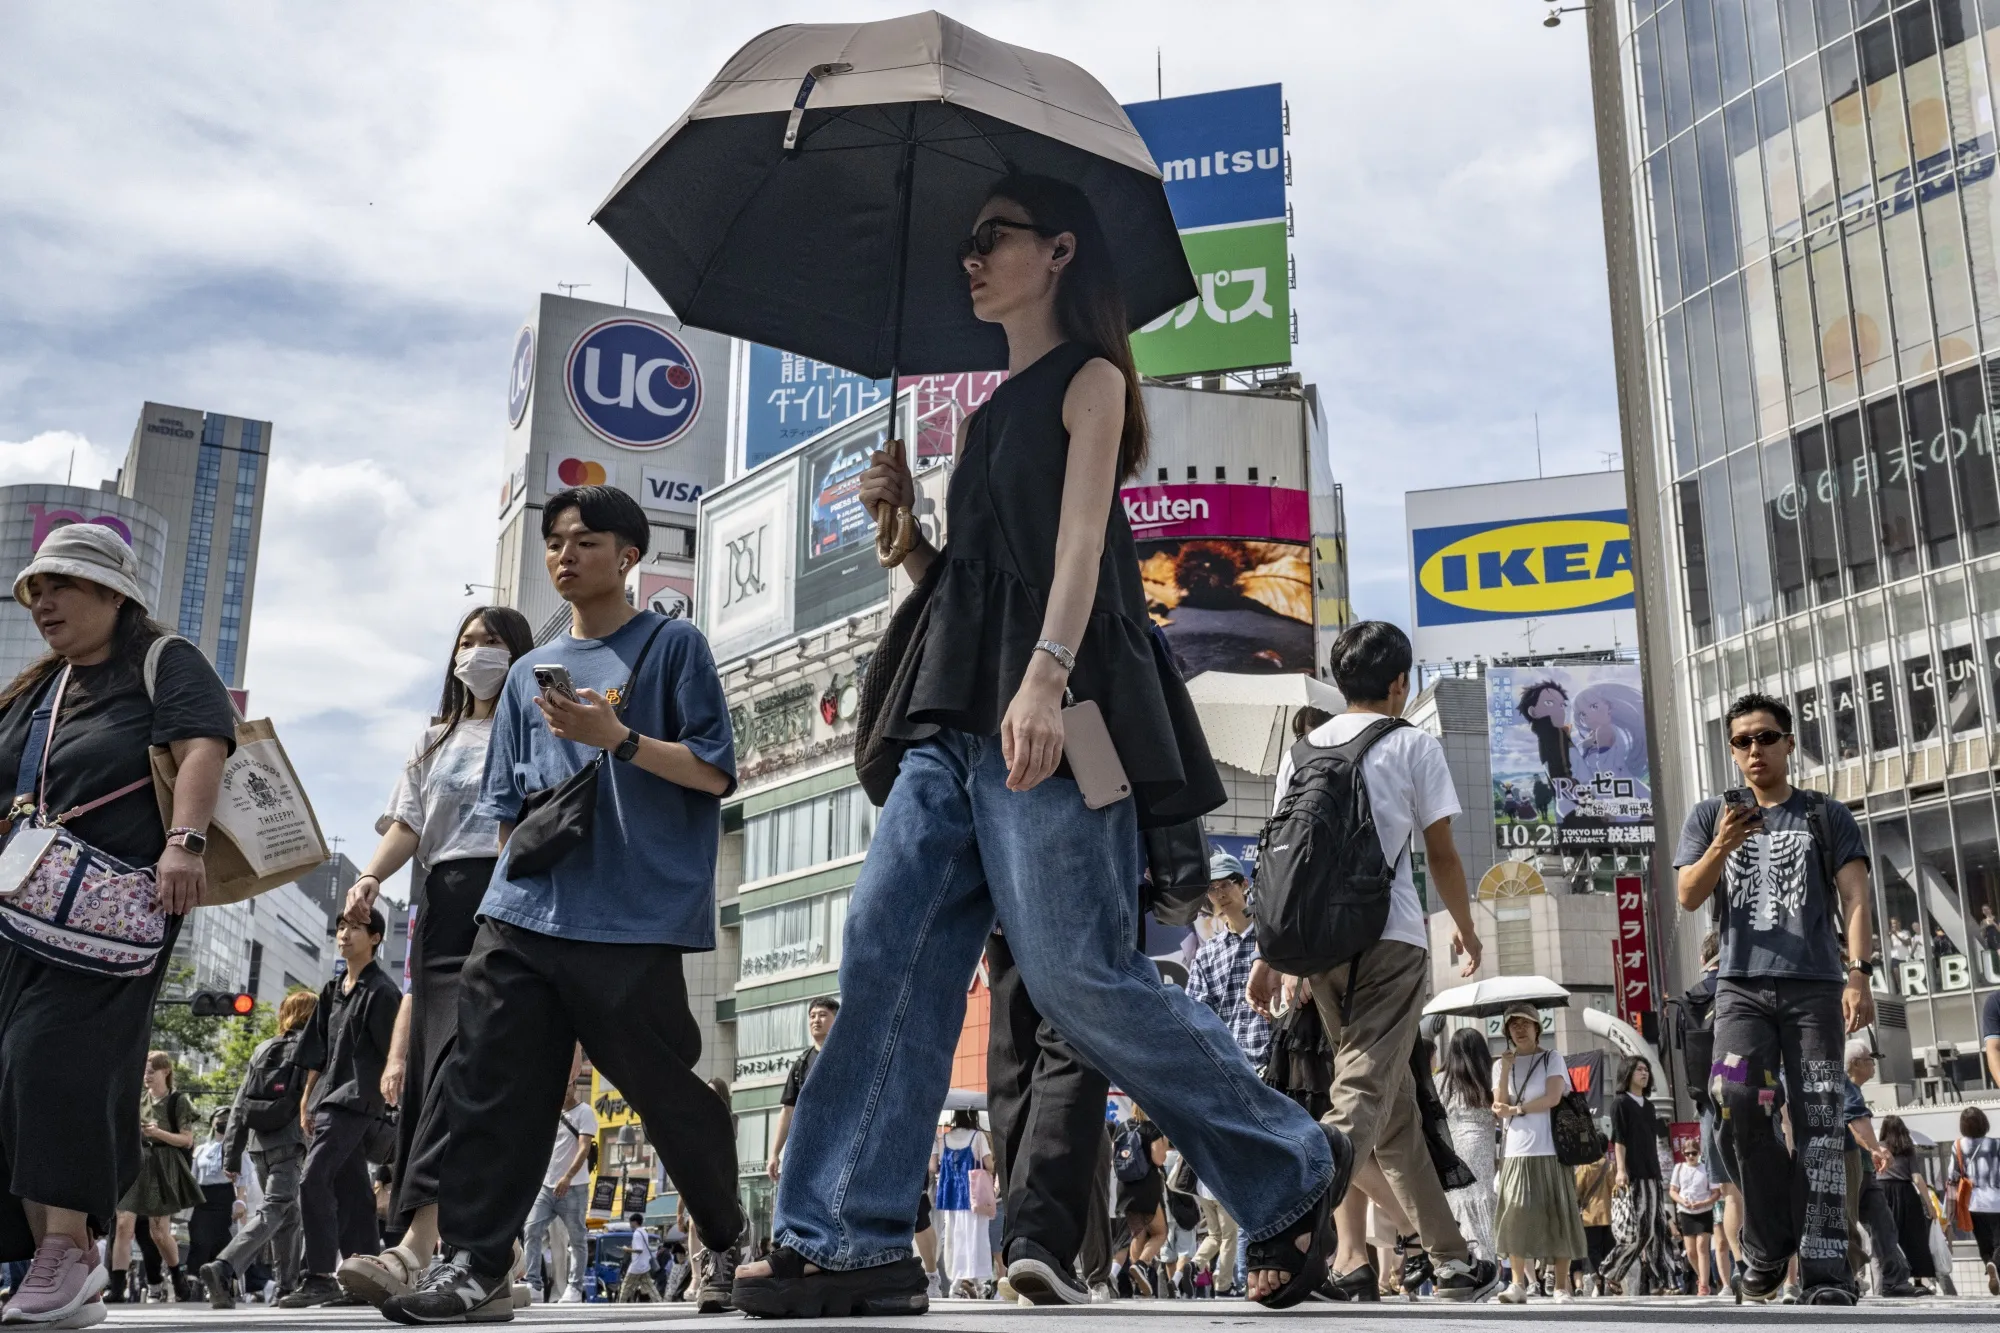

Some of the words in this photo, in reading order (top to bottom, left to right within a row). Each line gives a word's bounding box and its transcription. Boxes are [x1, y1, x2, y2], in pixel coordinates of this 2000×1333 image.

[1141, 267, 1273, 333] パス
[147, 424, 195, 439] INDIGO
[646, 478, 704, 502] VISA
[1442, 540, 1632, 593] IKEA
[223, 759, 251, 791] ADORABLE
[251, 760, 281, 778] GOODS
[258, 810, 296, 825] THREEPPY
[1501, 824, 1552, 846] 10.2
[1562, 828, 1591, 836] TOKYO
[1804, 1102, 1834, 1115] love
